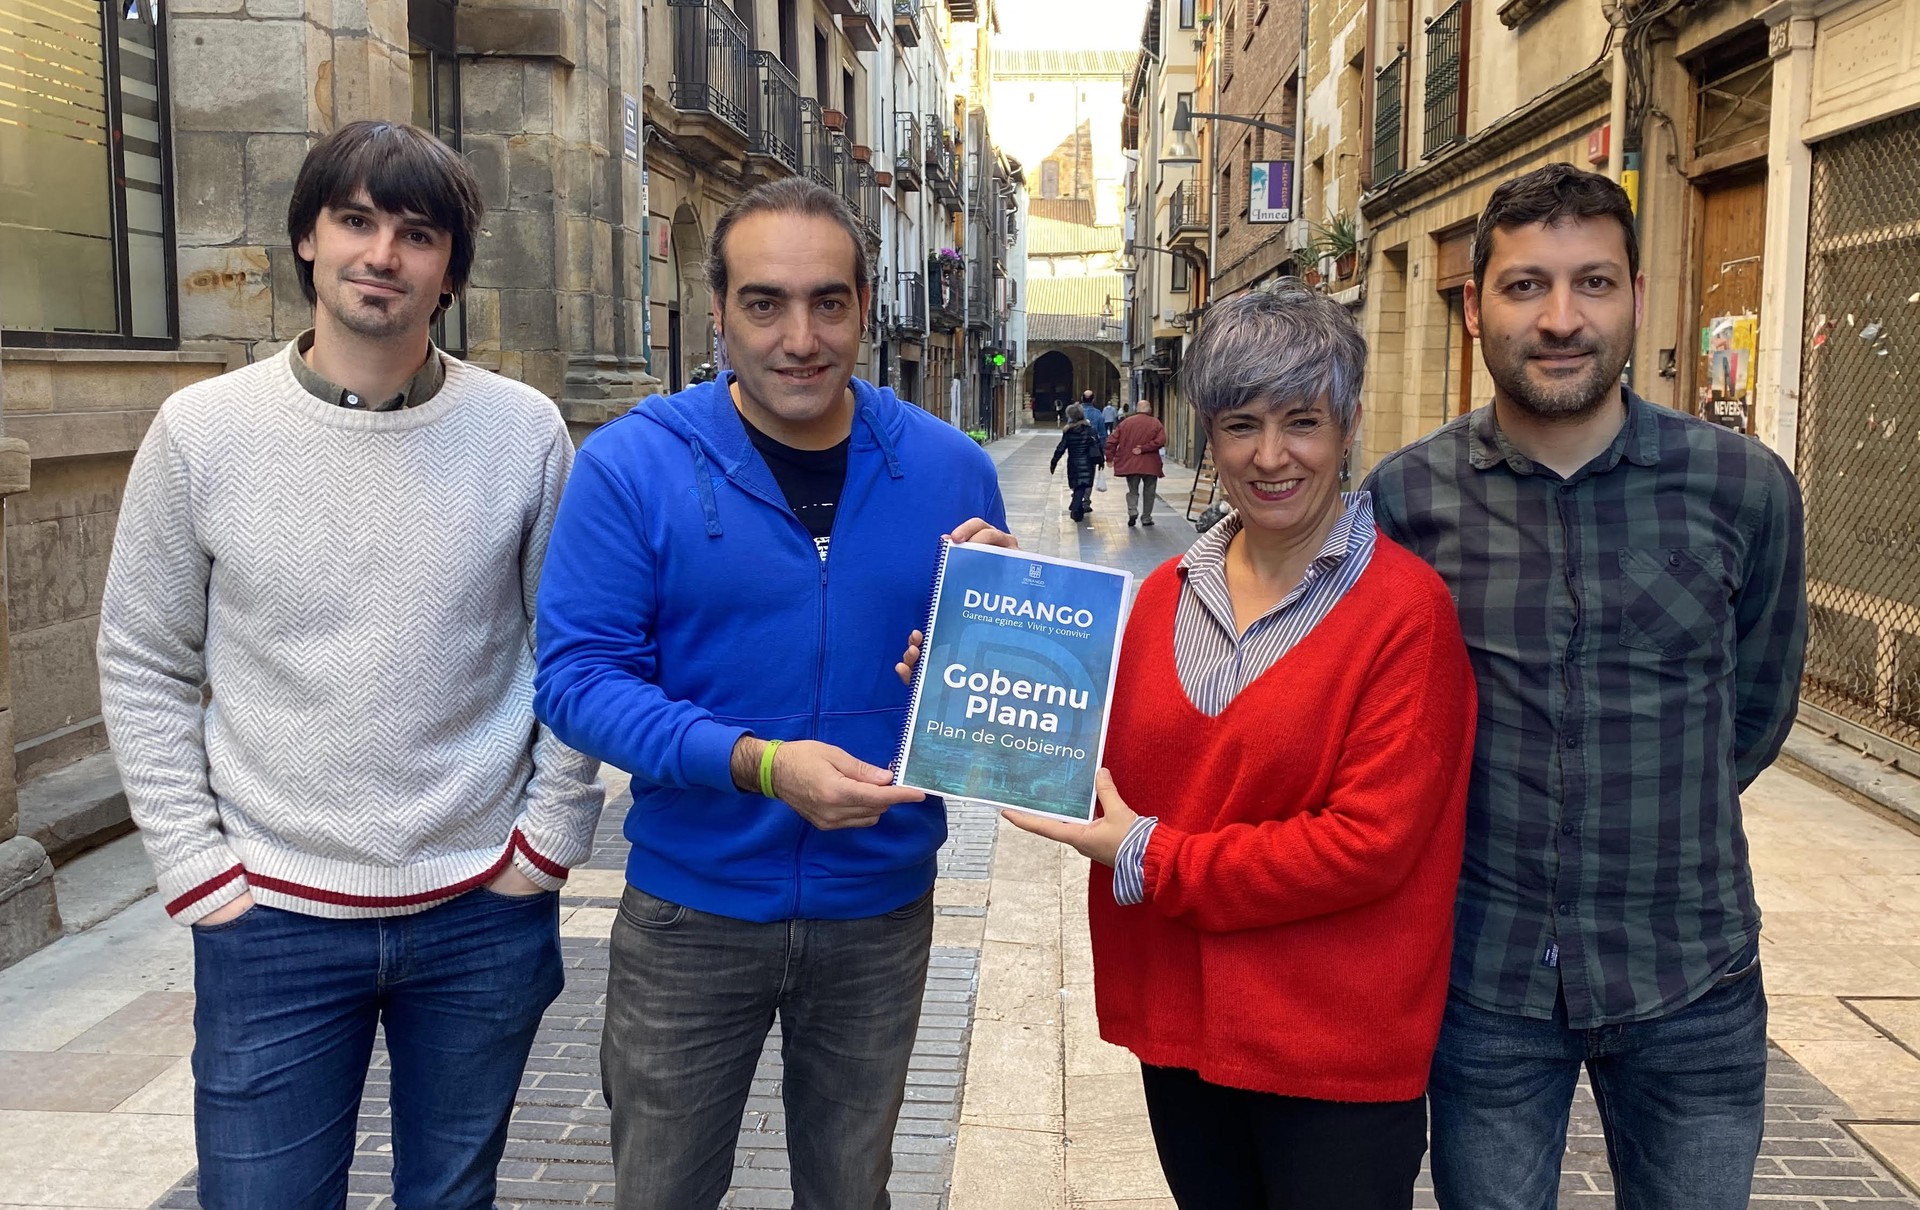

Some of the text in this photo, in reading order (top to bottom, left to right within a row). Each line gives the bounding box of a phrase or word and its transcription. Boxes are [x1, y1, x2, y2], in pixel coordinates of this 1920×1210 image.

[962, 609, 1091, 639] Garena eginez Vivir y convivir
[963, 588, 1093, 628] DURANGO
[943, 663, 1089, 710] Gobernu
[965, 695, 1059, 733] Plana
[926, 720, 1086, 760] Plan de Gobierno
